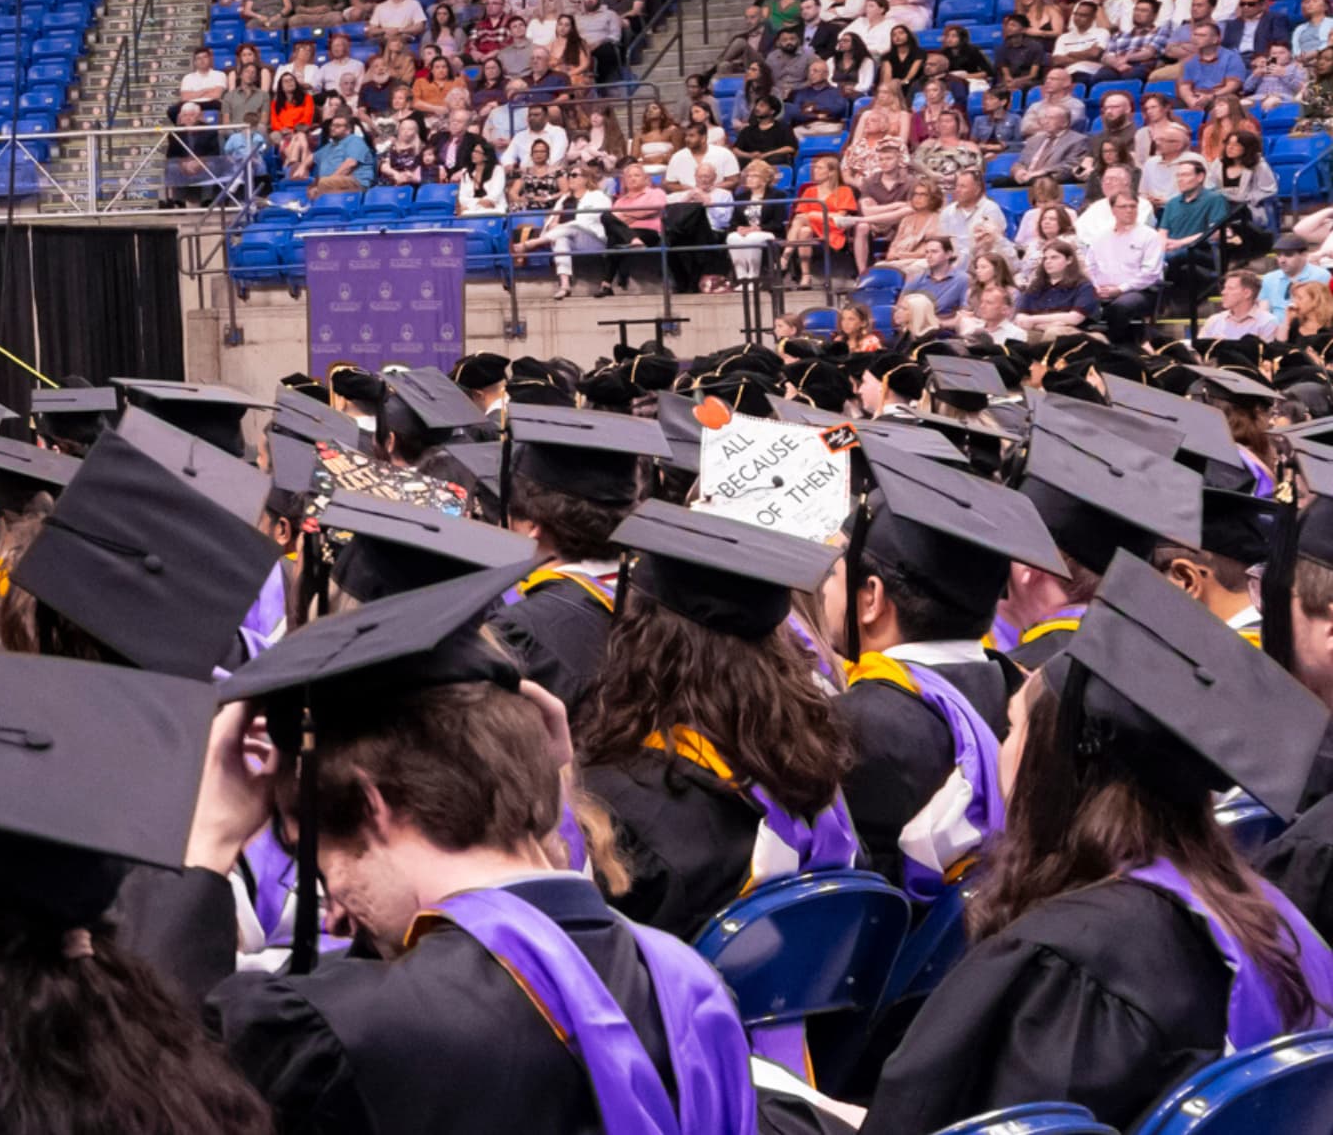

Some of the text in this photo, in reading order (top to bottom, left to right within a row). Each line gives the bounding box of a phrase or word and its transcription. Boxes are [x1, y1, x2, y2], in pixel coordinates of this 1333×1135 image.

[717, 435, 799, 498] BECAUSE
[722, 434, 755, 460] ALL
[756, 462, 840, 526] OF THEM
